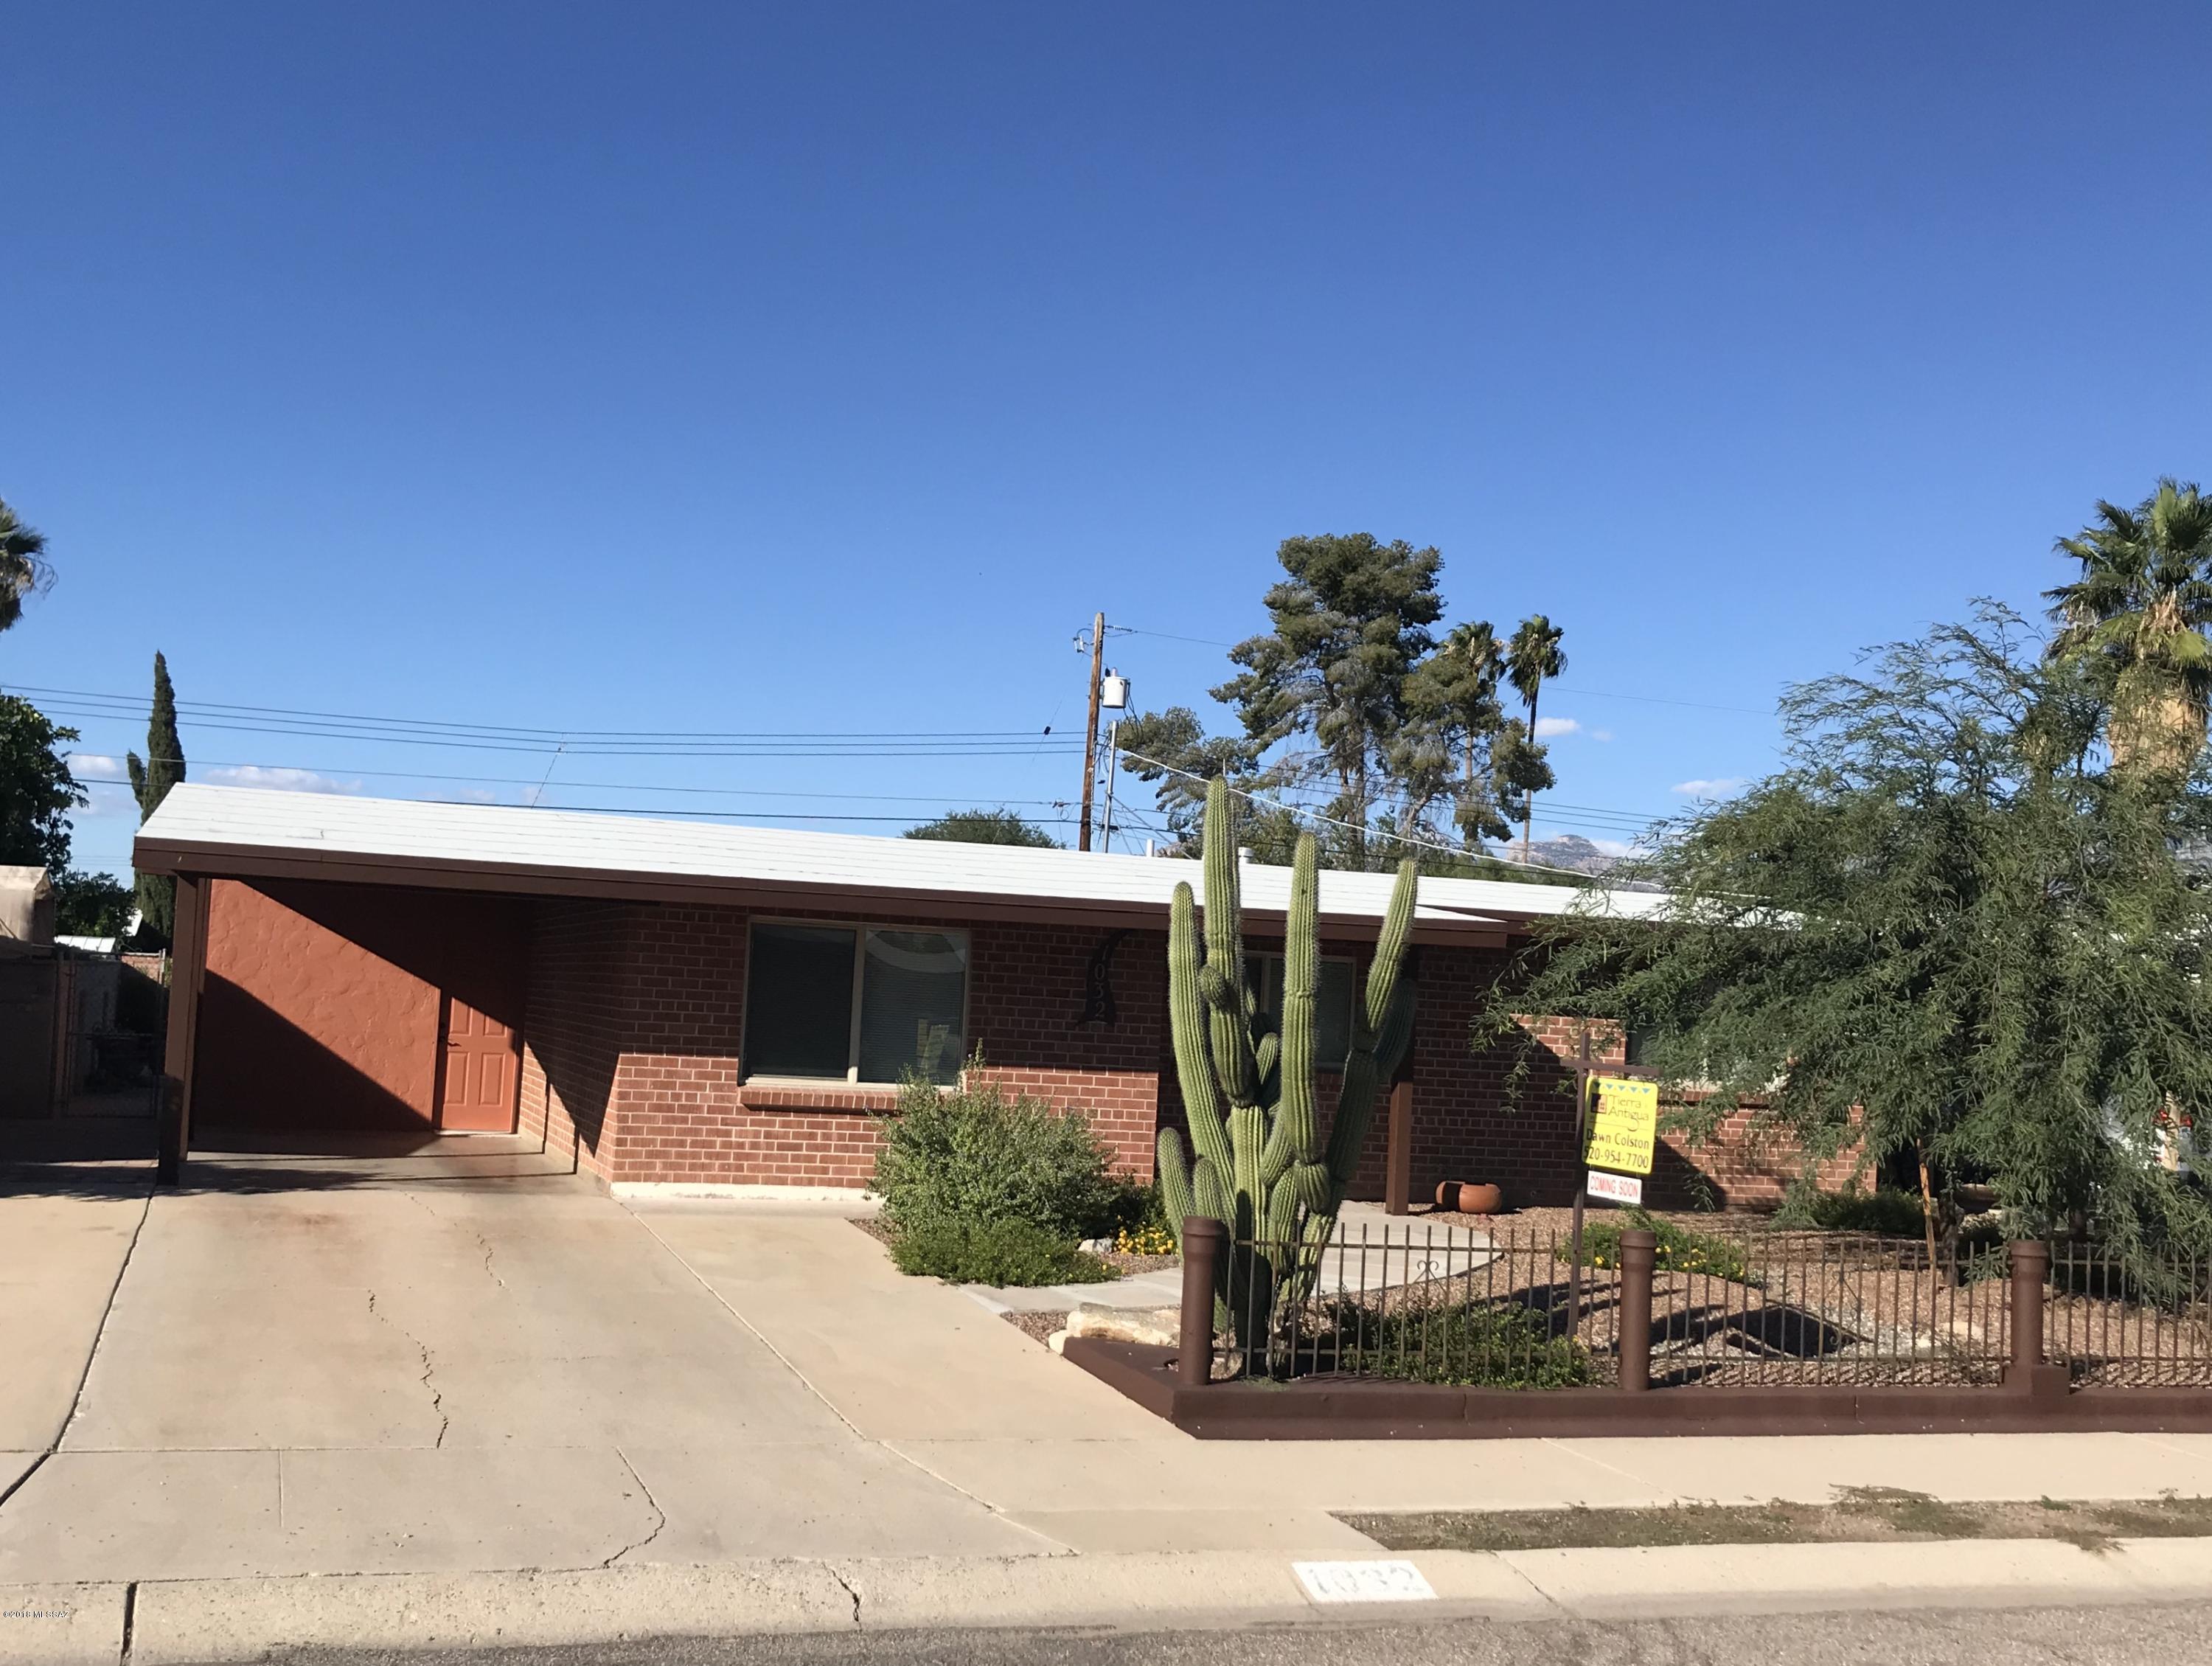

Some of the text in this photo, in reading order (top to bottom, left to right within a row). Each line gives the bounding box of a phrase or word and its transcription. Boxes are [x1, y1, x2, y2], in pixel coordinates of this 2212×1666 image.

[1608, 1094, 1641, 1108] Tierra
[1608, 1106, 1649, 1131] Antigua
[1586, 1128, 1649, 1150] Dawn Colston
[1585, 1146, 1649, 1169] 520-954-7700
[1590, 1176, 1638, 1198] COMING SOON
